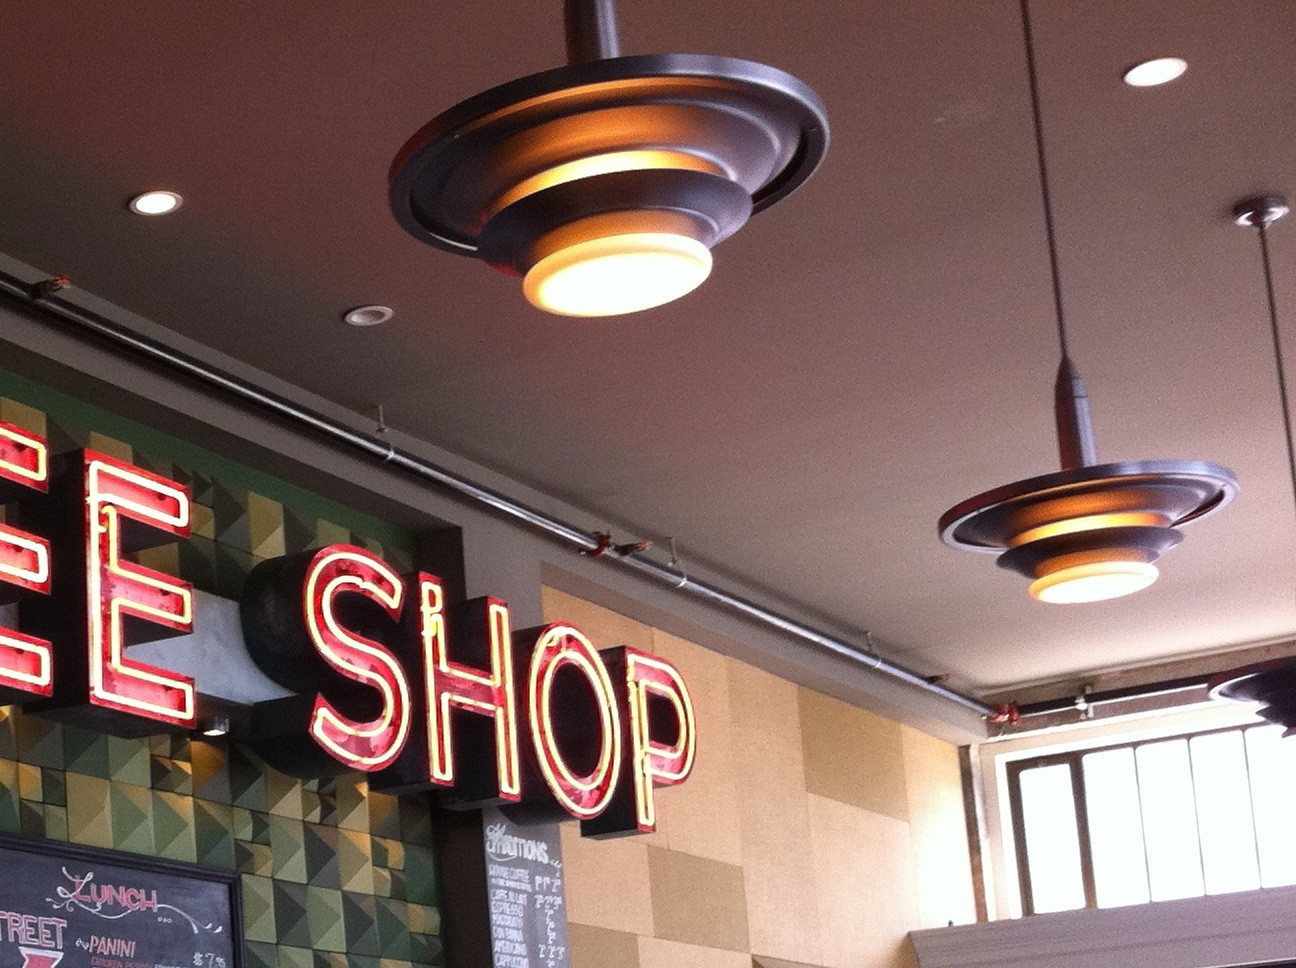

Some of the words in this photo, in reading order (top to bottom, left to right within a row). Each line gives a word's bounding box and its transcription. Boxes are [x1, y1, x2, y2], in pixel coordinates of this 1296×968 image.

[301, 545, 697, 832] SHOP
[57, 867, 159, 912] LUNCH
[89, 935, 136, 958] PANINI
